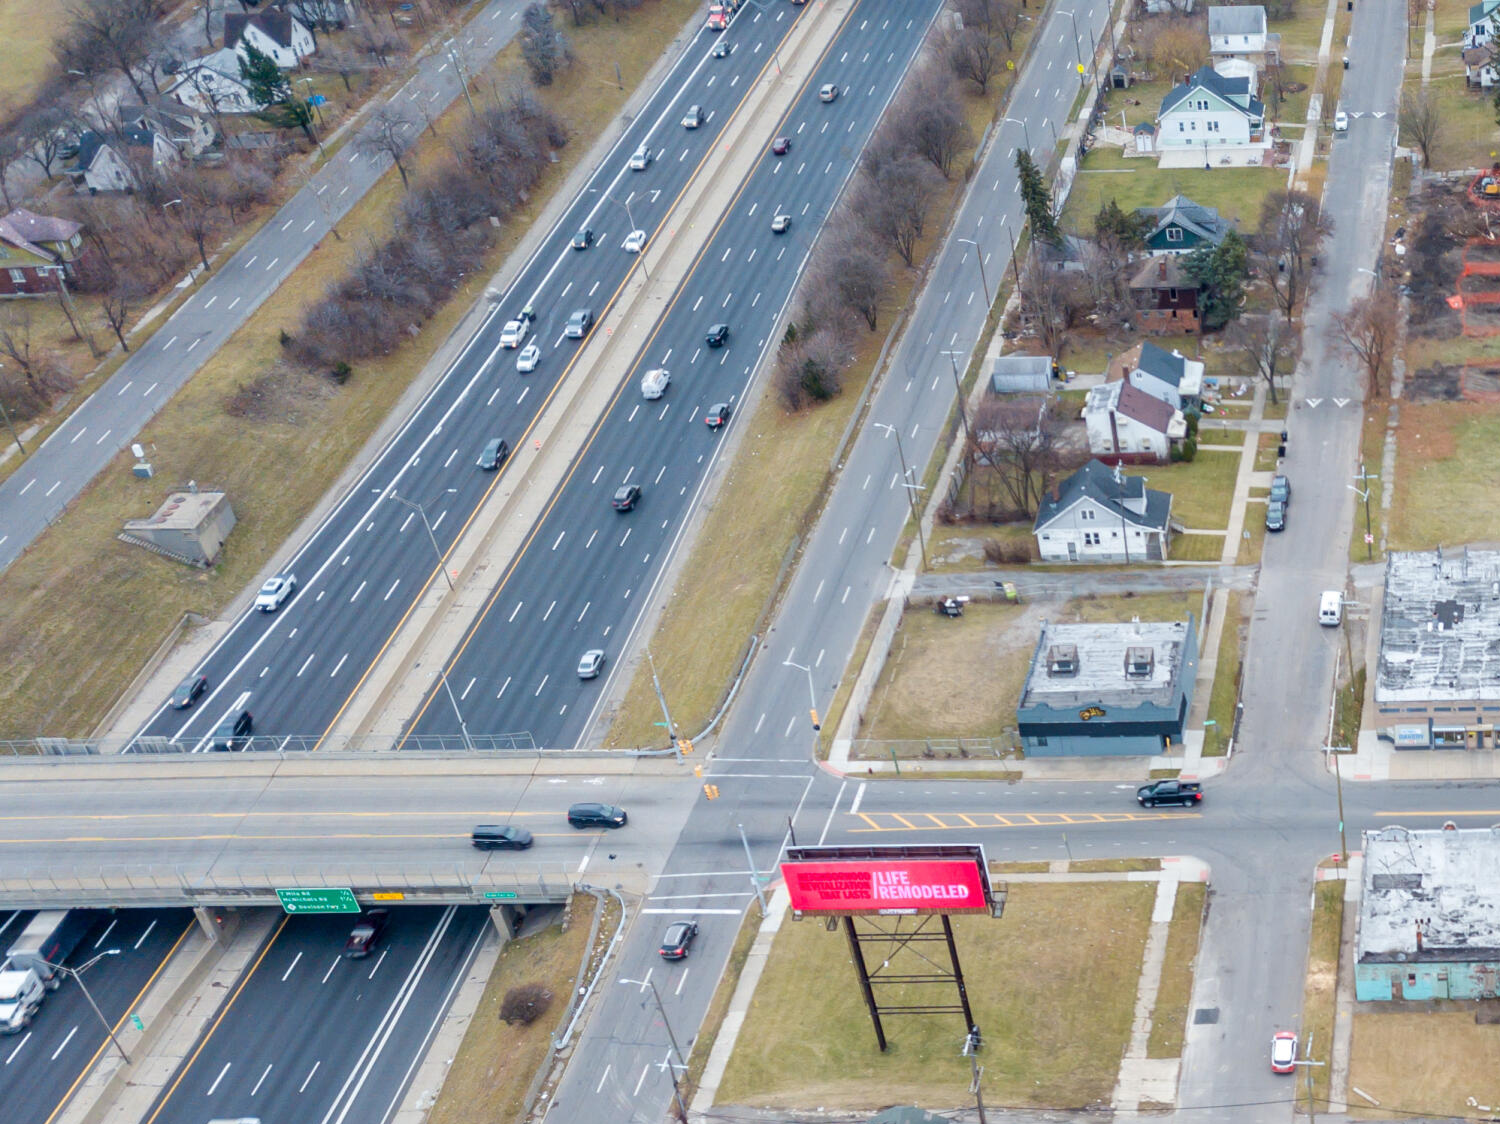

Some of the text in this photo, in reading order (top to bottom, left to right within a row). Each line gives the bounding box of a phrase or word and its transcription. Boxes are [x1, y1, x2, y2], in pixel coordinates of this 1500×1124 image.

[877, 871, 910, 885] LIFE
[799, 881, 871, 891] REVITALIZATION
[878, 884, 969, 900] REMODELED
[819, 890, 871, 900] THAT LASTS
